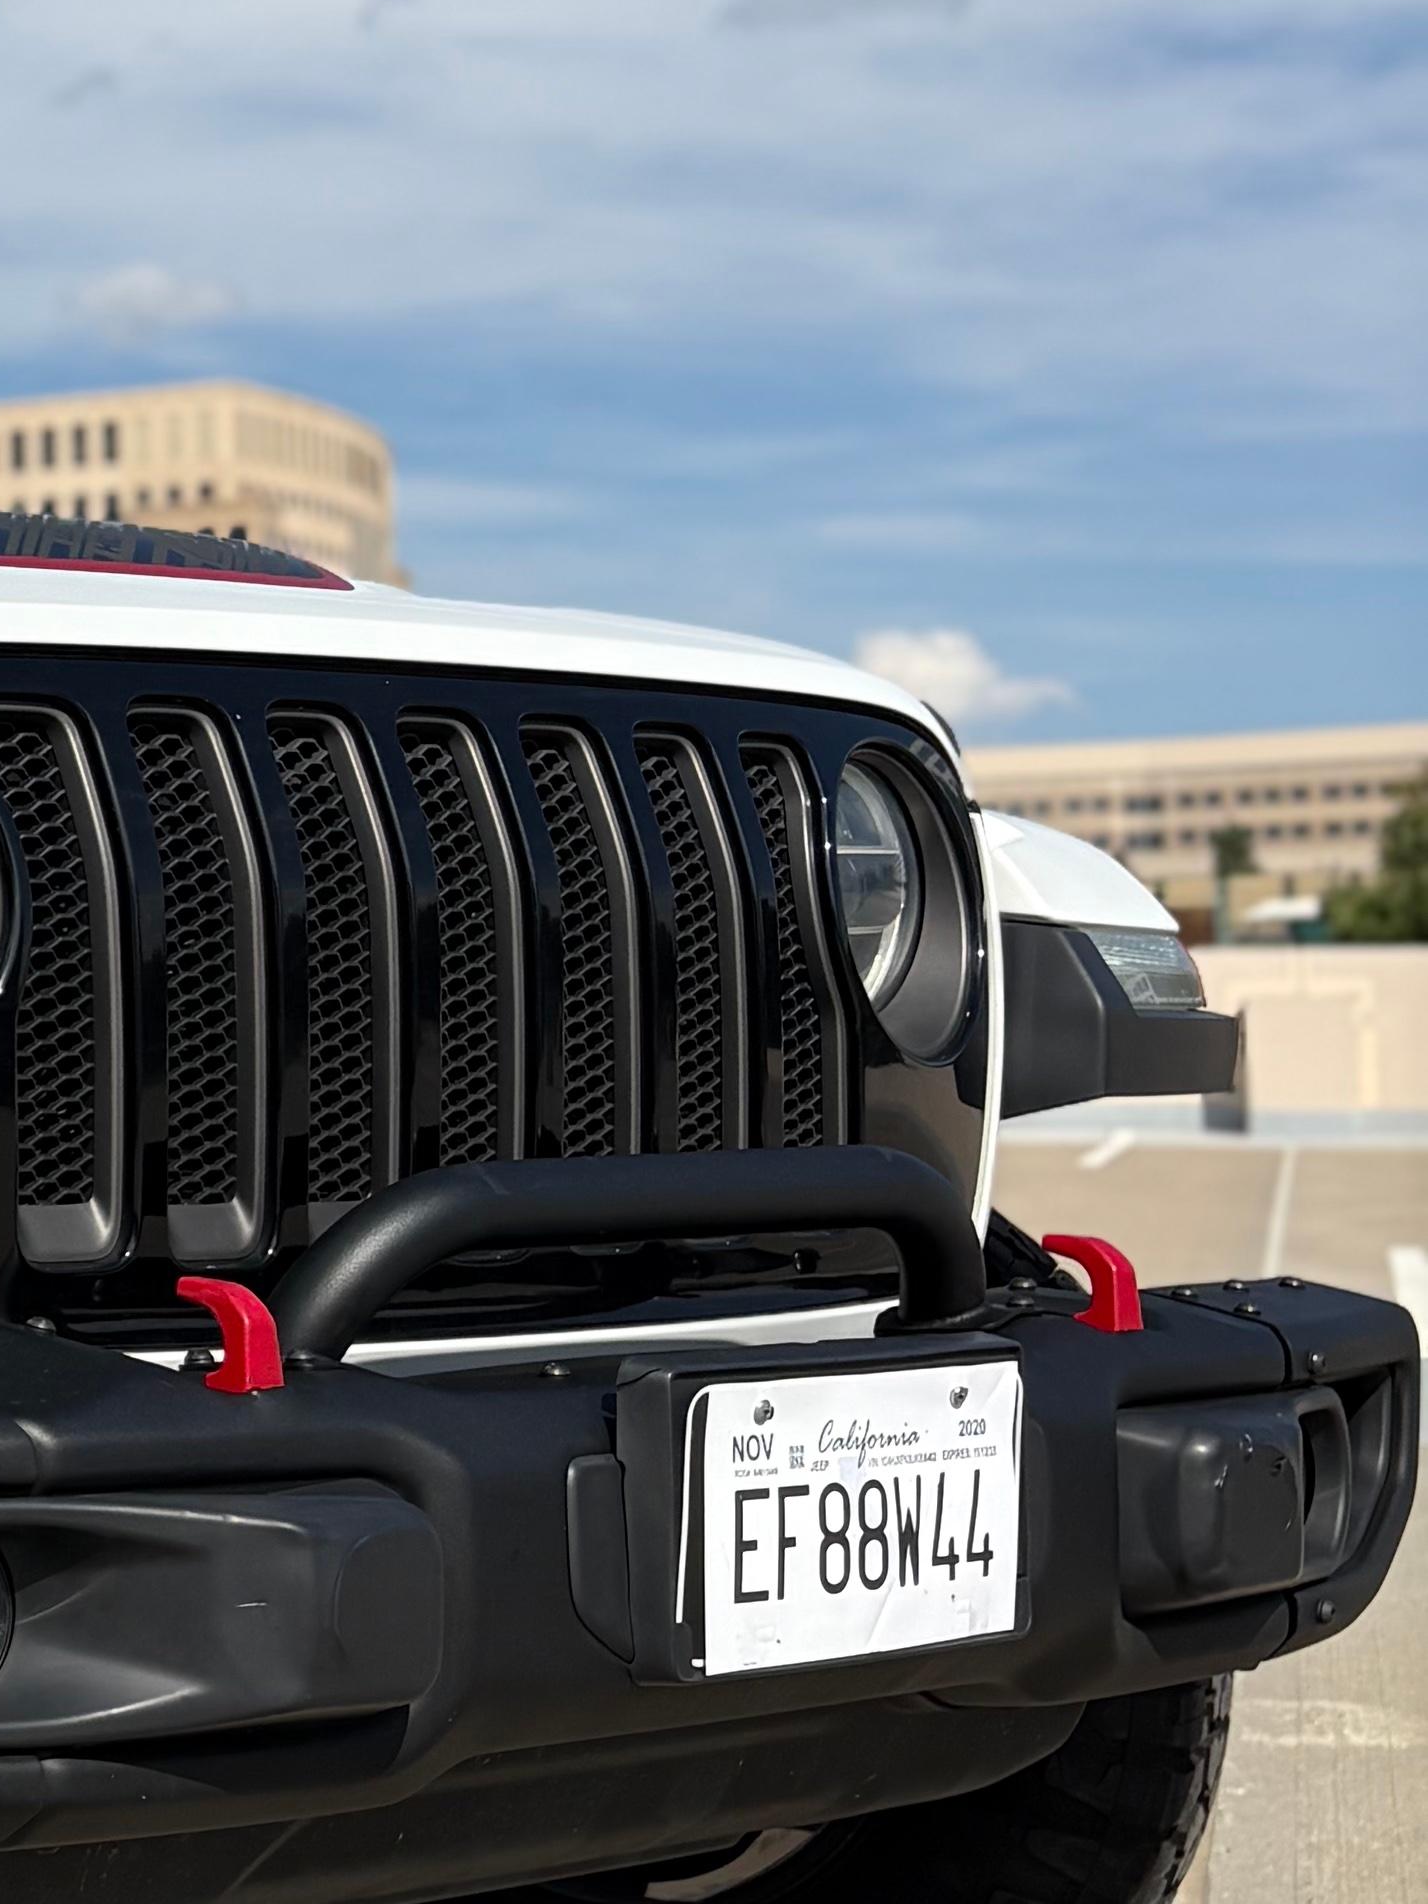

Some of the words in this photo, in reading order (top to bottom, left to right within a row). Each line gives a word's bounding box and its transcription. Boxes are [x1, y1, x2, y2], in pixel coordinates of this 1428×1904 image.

[732, 1433, 775, 1463] NOV
[817, 1419, 921, 1469] California
[957, 1418, 987, 1437] 2020
[733, 1469, 994, 1604] EF88W44
